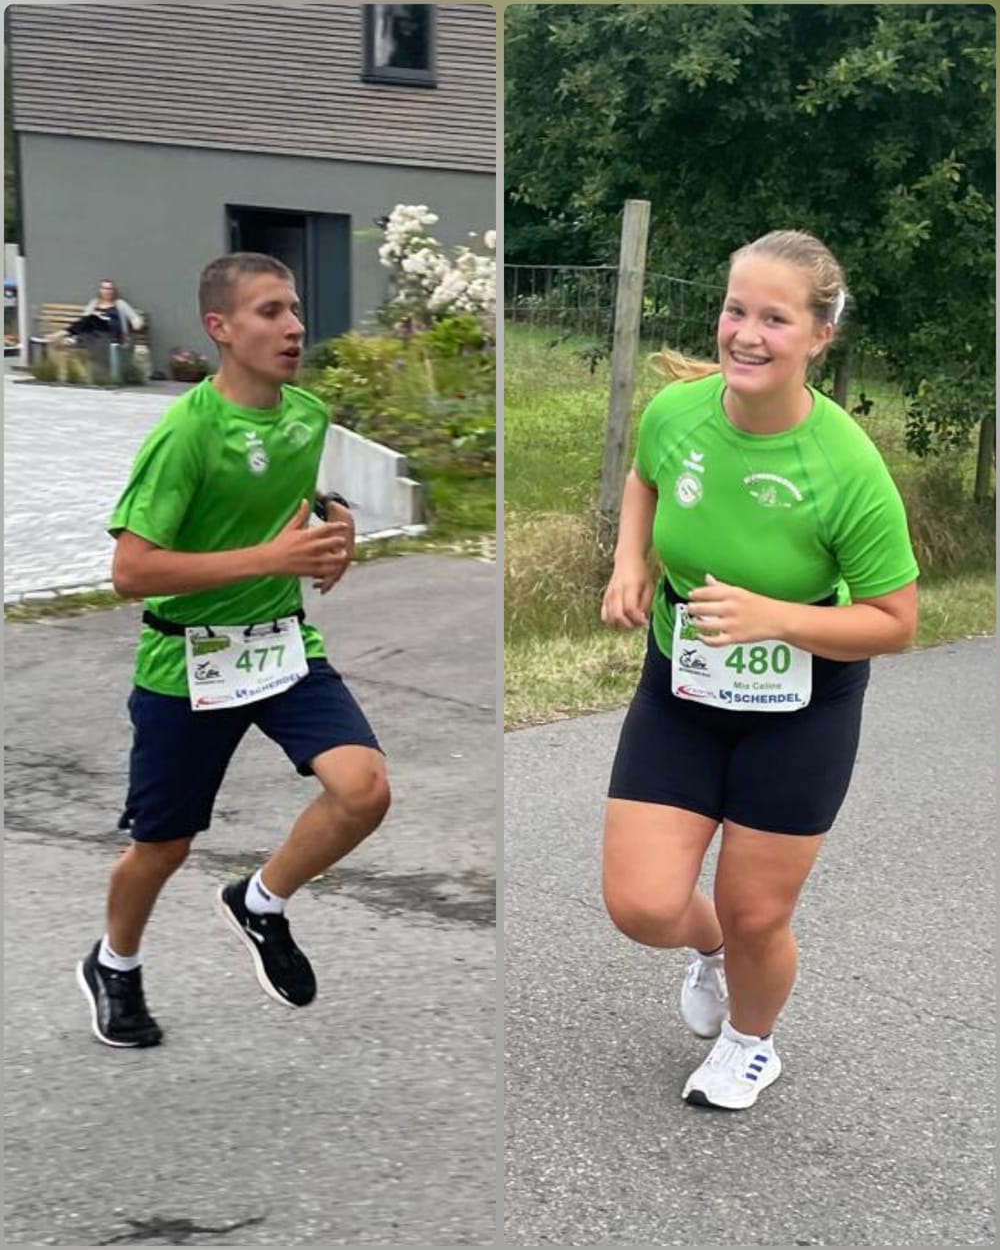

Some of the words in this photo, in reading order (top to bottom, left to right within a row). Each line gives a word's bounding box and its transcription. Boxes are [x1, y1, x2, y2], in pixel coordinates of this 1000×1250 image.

[235, 645, 285, 672] 477
[725, 644, 791, 674] 480
[734, 693, 802, 703] SCHERDEL
